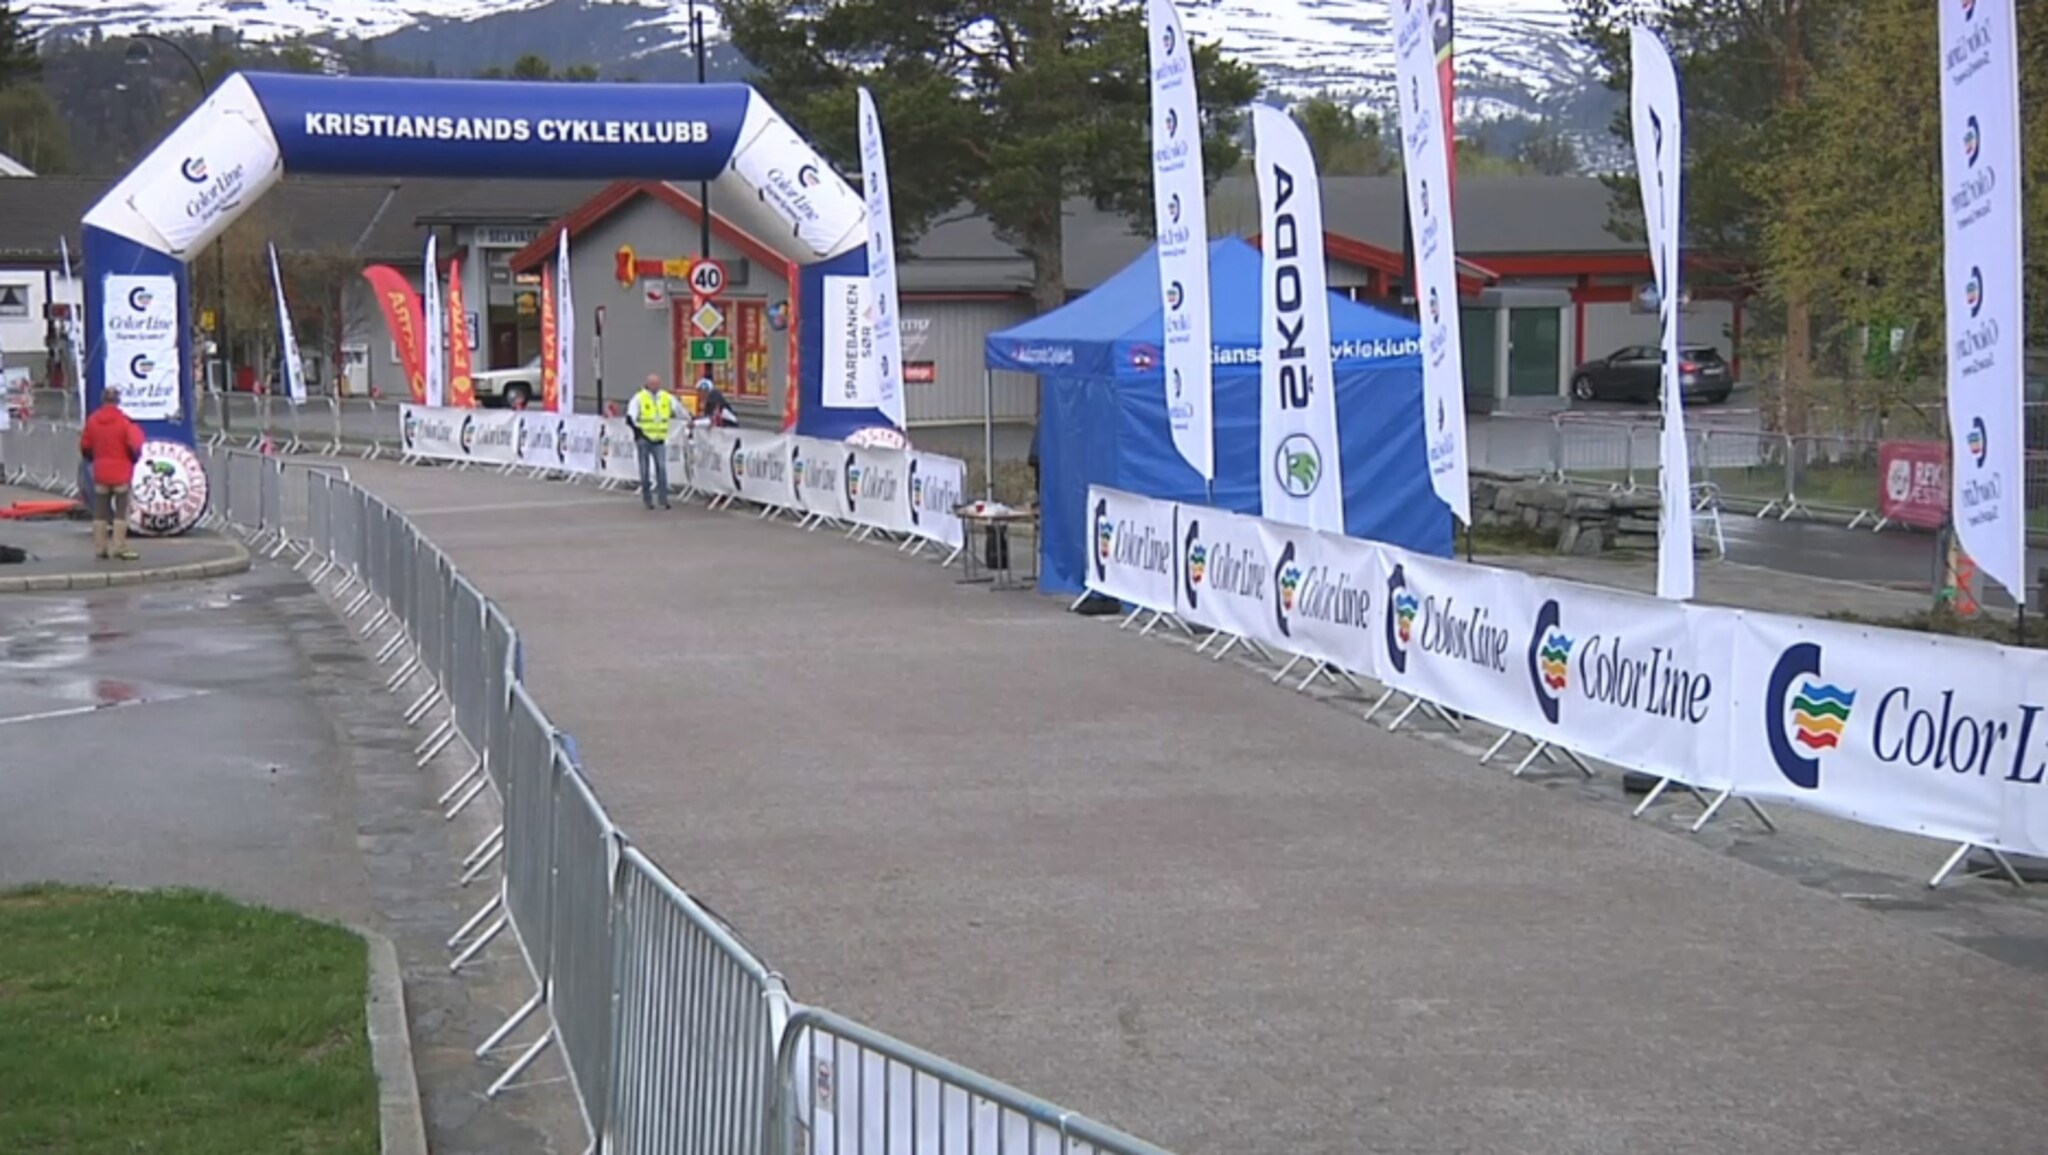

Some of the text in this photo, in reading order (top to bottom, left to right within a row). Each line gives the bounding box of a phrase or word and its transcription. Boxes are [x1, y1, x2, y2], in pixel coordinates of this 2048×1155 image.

[305, 112, 709, 143] KRISTIANSANDS CYKLEKLUBB
[695, 269, 720, 288] 40
[703, 343, 713, 357] 9
[845, 284, 858, 400] SPAREBANKEN
[861, 326, 872, 358] SØR
[1579, 633, 1712, 724] Color Line
[1873, 686, 2008, 776] Color
